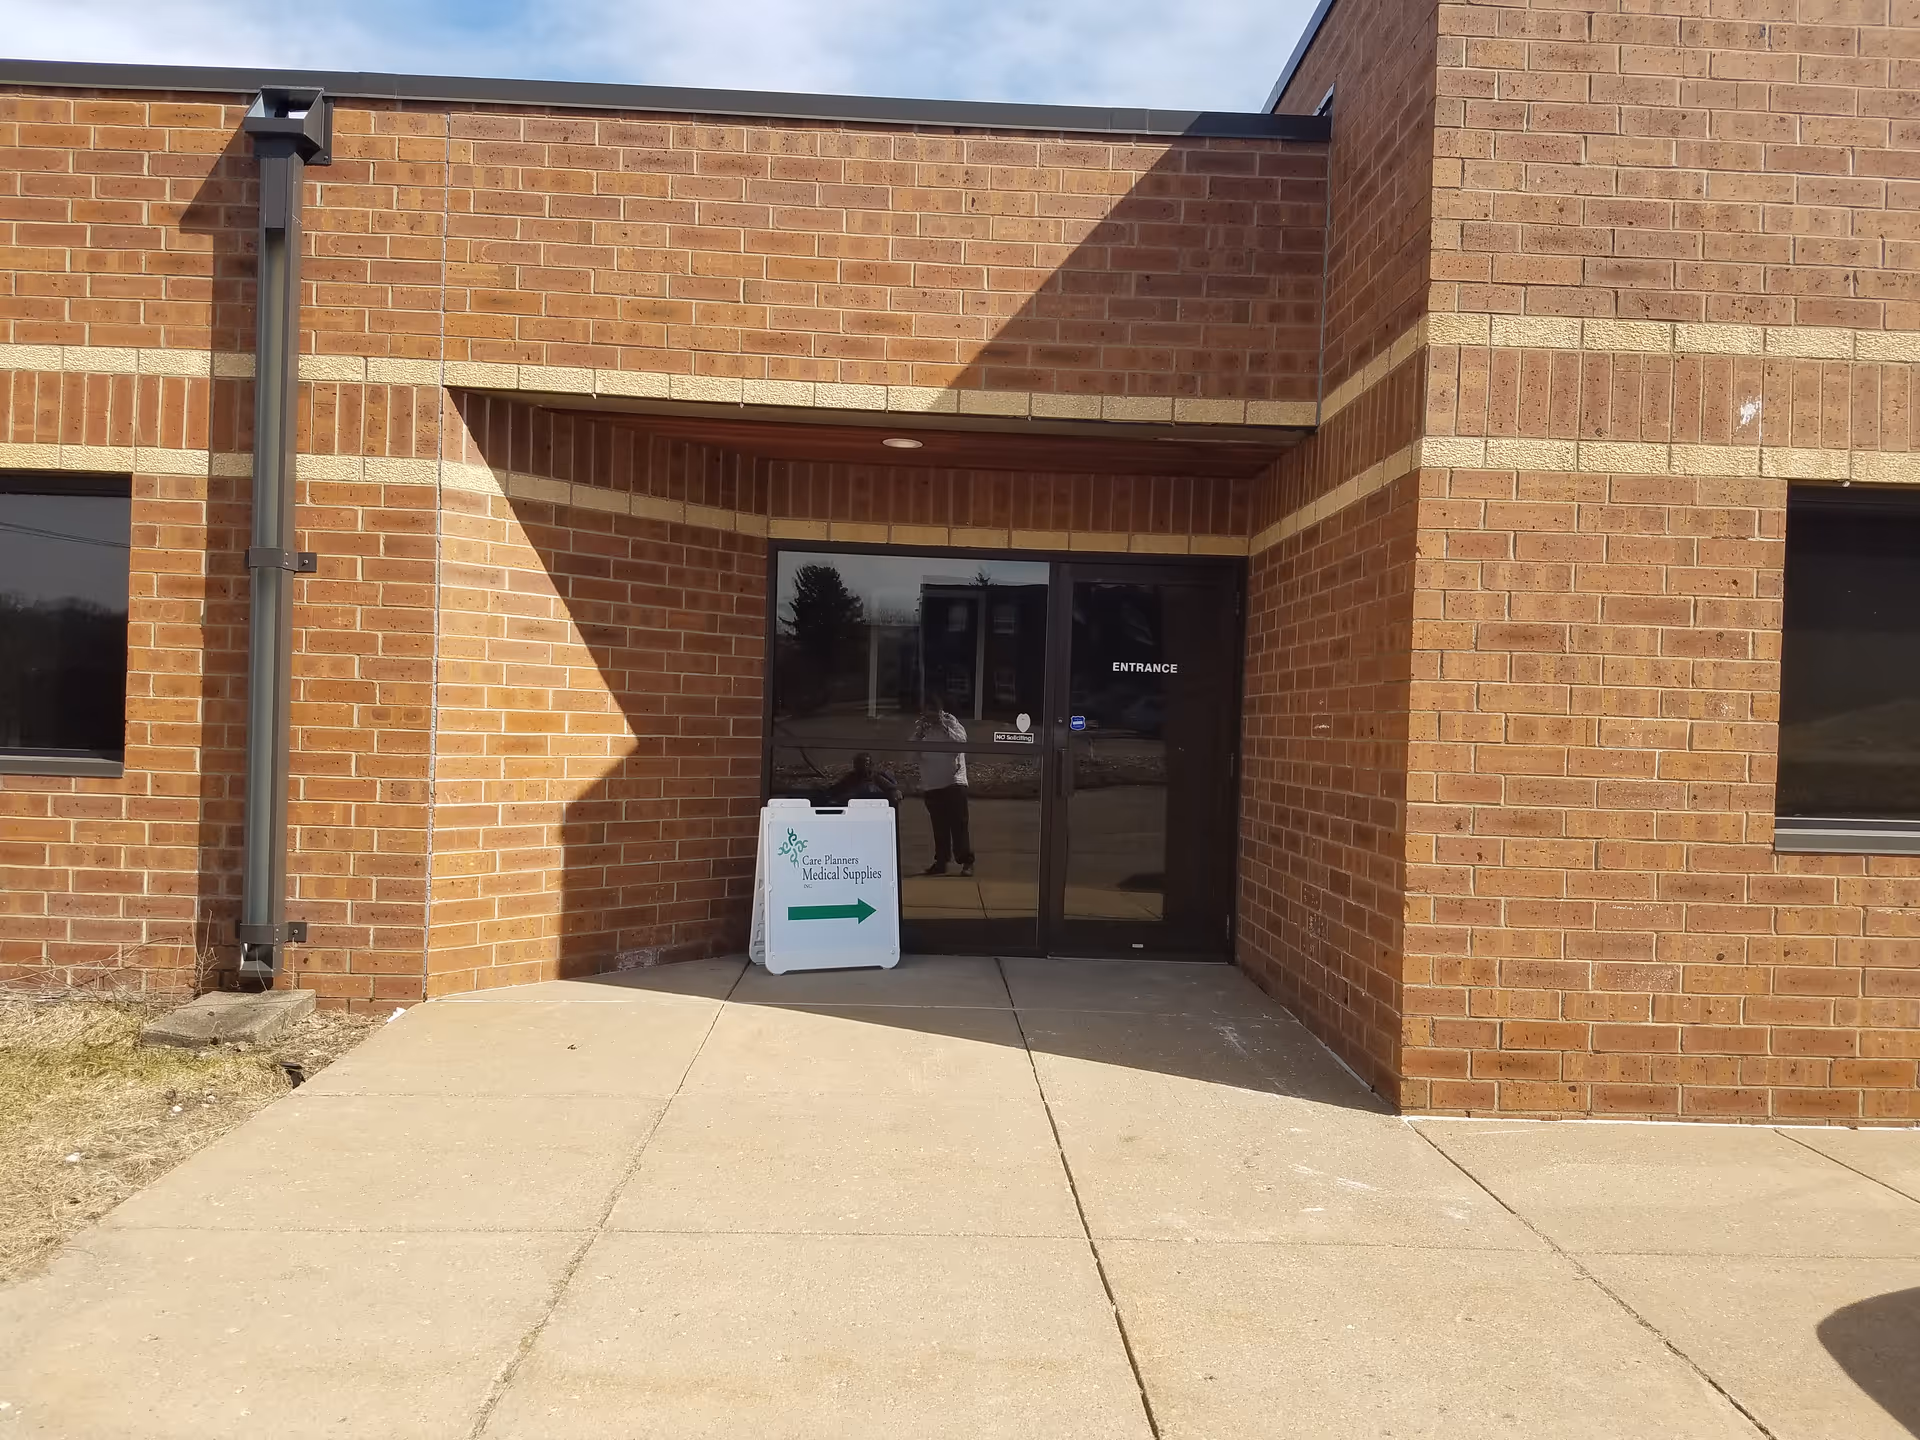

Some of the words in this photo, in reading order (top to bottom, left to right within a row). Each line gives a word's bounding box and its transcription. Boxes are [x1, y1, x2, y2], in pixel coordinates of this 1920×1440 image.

[1112, 662, 1178, 674] ENTRANCE
[802, 855, 822, 866] Care
[824, 854, 859, 865] Planners
[802, 866, 840, 880] Medical
[842, 865, 882, 885] Supplies
